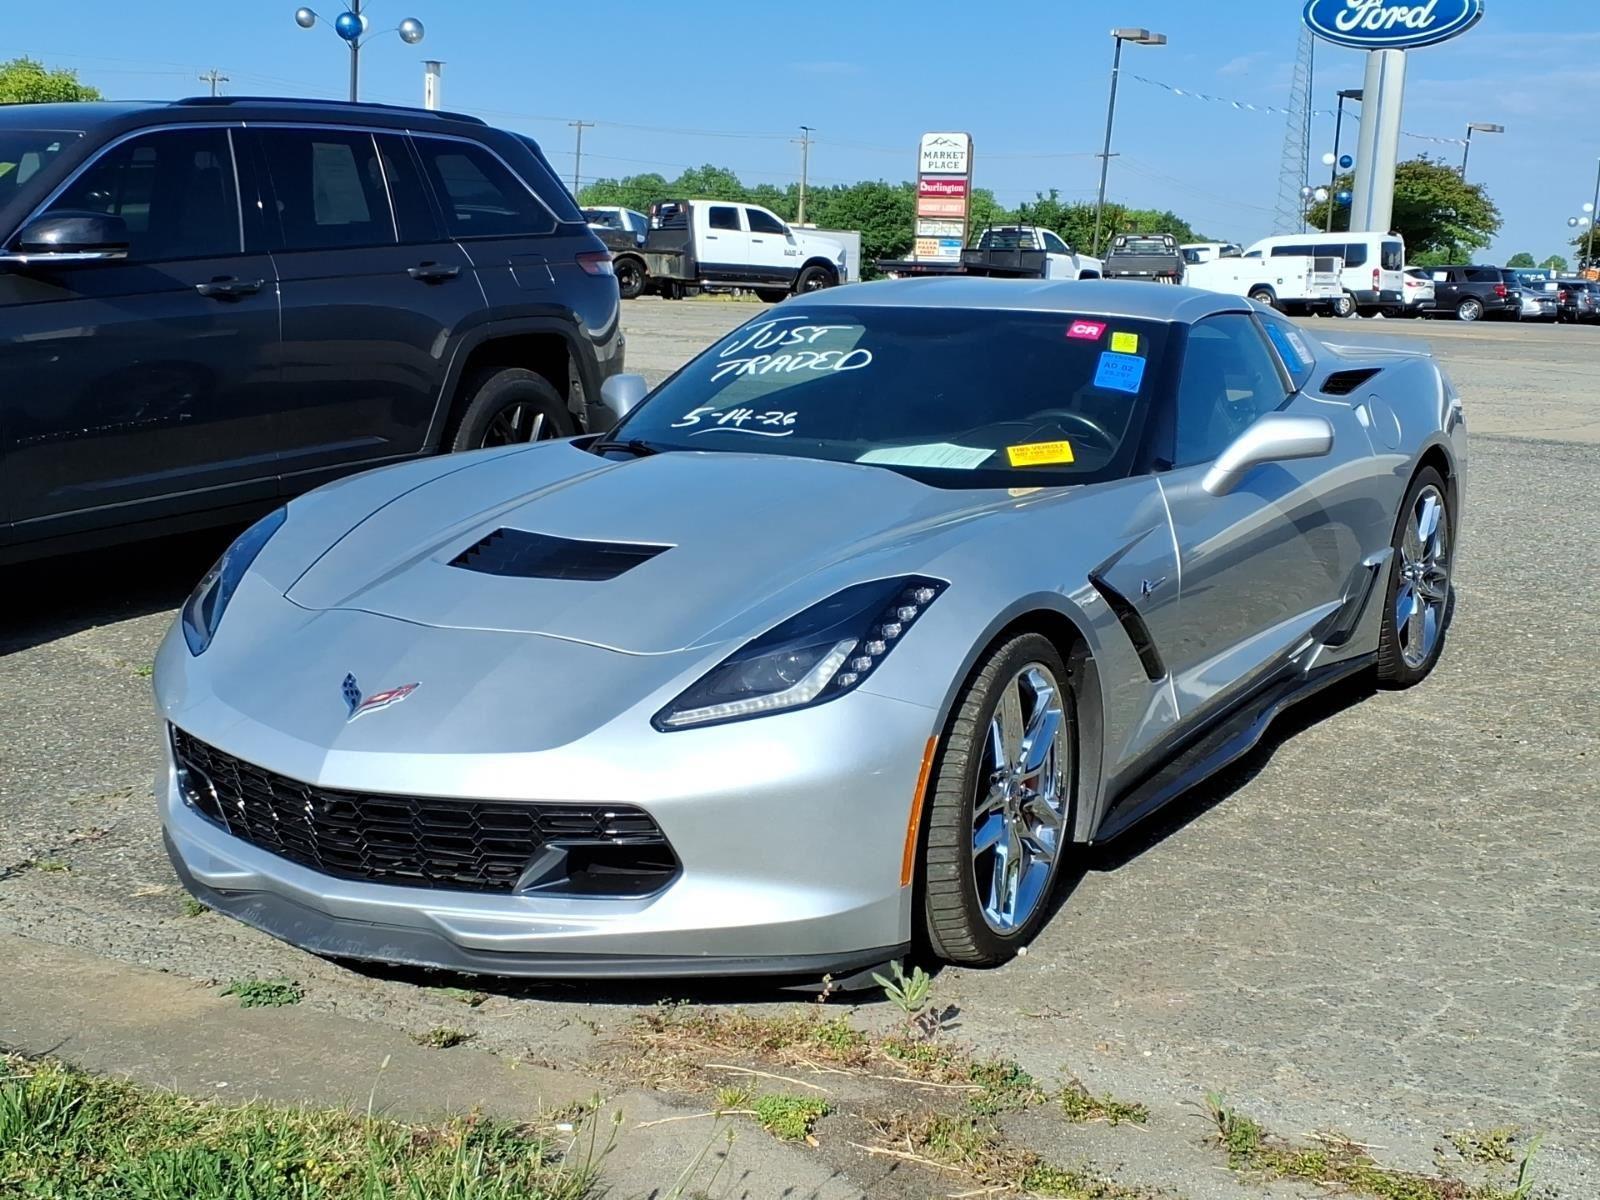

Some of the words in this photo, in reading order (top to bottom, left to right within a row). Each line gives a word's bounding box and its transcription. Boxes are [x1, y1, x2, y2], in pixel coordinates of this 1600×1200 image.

[1335, 0, 1436, 31] Ford
[923, 151, 966, 160] MARKET
[928, 161, 960, 169] PLACE
[920, 181, 964, 194] Burlington
[1072, 324, 1099, 336] CR
[719, 316, 853, 358] JUST
[710, 349, 873, 382] TRADED
[671, 407, 798, 428] 5-14-26
[1032, 443, 1065, 451] VEHICLE
